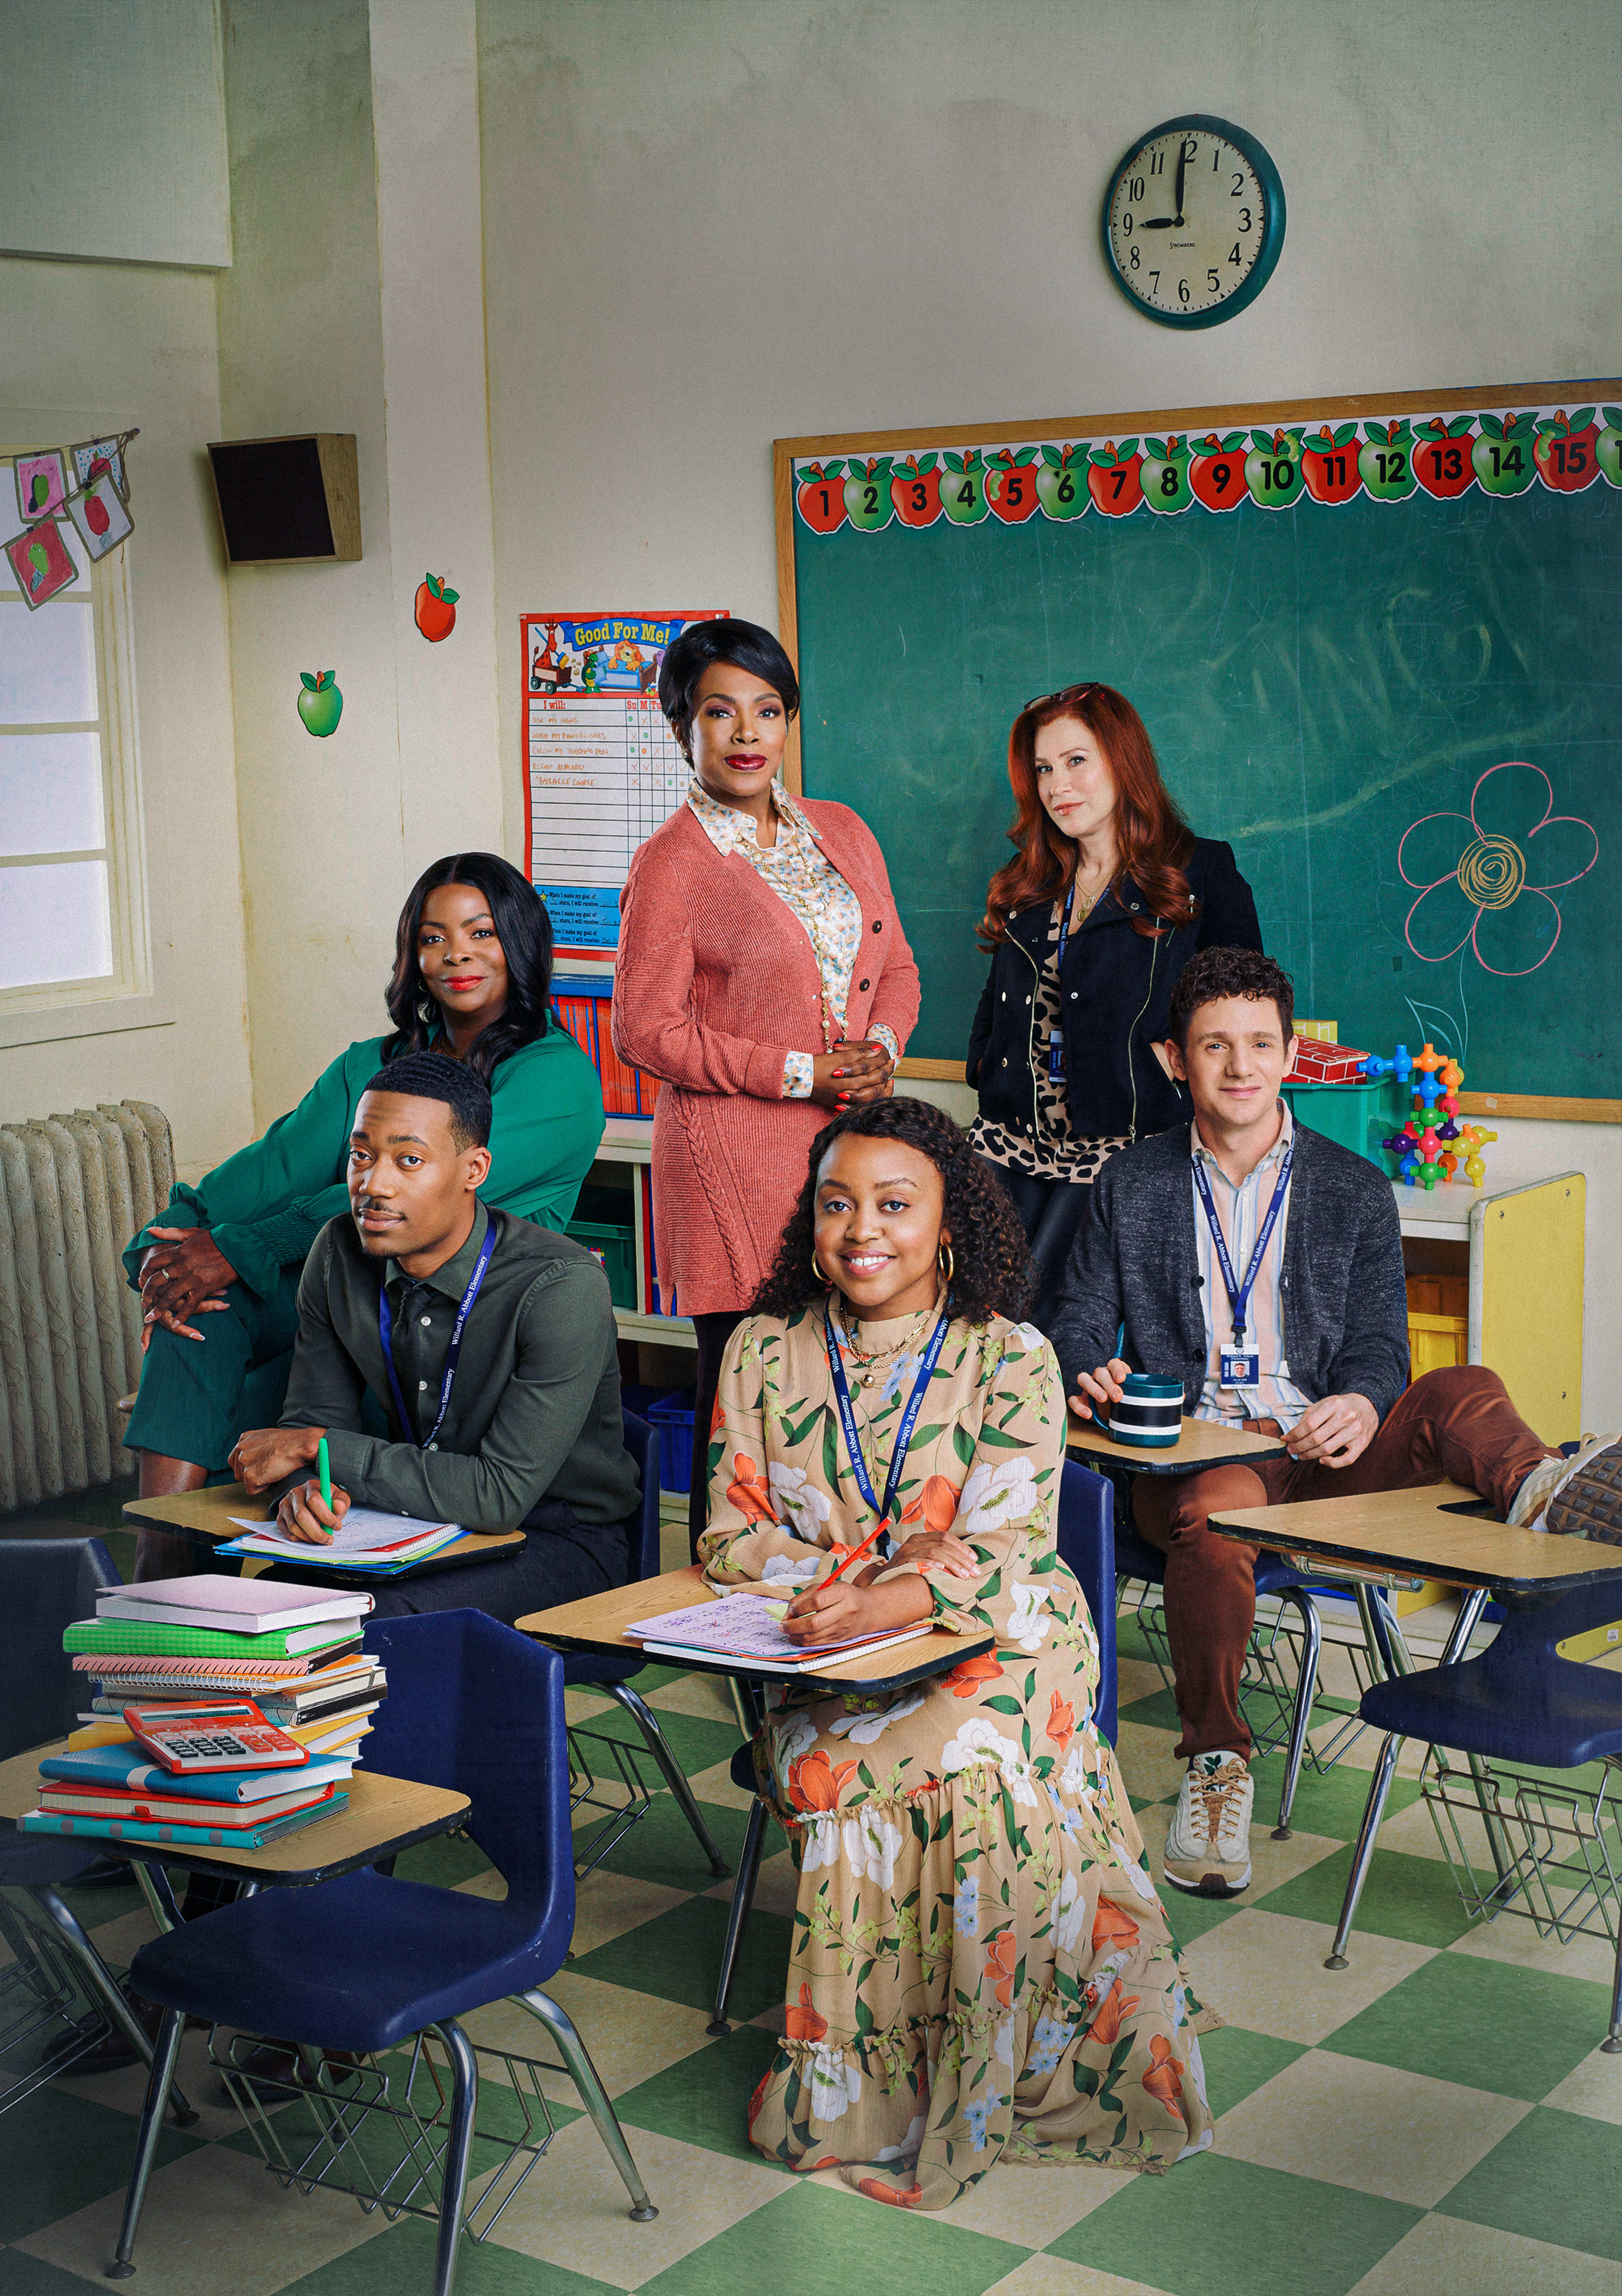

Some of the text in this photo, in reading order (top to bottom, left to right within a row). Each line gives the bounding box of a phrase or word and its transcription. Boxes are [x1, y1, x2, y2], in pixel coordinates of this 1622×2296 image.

[1150, 151, 1165, 175] 11
[1212, 149, 1219, 172] 1
[1129, 177, 1145, 202] 10
[1230, 173, 1244, 197] 2
[1123, 213, 1133, 237] 9
[1238, 208, 1252, 233] 3
[1130, 246, 1140, 269] 8
[1228, 242, 1242, 266] 4
[1149, 270, 1160, 294] 7
[1178, 279, 1190, 303] 6
[1207, 268, 1220, 292] 5
[820, 490, 829, 517] 1
[863, 487, 879, 514] 2
[912, 483, 927, 511] 3
[957, 480, 976, 507] 4
[1006, 478, 1023, 507] 5
[1058, 474, 1075, 503] 6
[1111, 471, 1127, 500] 7
[1161, 467, 1179, 497] 8
[1212, 464, 1231, 494] 9
[1261, 460, 1295, 491] 10
[1323, 456, 1346, 487] 11
[1375, 452, 1407, 483] 12
[1430, 448, 1463, 480] 13
[1489, 445, 1526, 477] 14
[1554, 442, 1588, 474] 15
[575, 622, 670, 646] Good For Me!
[543, 700, 662, 710] I will: Su M Tu
[536, 775, 571, 785] BSTACLE
[1276, 1171, 1287, 1191] Willard
[1210, 1215, 1220, 1235] Willard
[1218, 1242, 1227, 1261] Abbott
[1223, 1261, 1236, 1293] Elementary
[1244, 1266, 1256, 1286] Willard
[1255, 1240, 1265, 1259] Abbott
[1260, 1210, 1276, 1240] Elementary
[451, 1321, 462, 1345] Willard
[461, 1291, 474, 1313] Abbott
[469, 1255, 488, 1291] Elementary
[829, 1341, 835, 1351] R.
[924, 1316, 949, 1371] Abbott Elementary
[830, 1351, 840, 1373] Willard
[442, 1368, 455, 1403] Elementary
[909, 1393, 923, 1416] Willard
[840, 1395, 868, 1491] Willard R. Abbott Elementary
[899, 1423, 912, 1447] Abbott
[888, 1448, 906, 1489] Elementary
